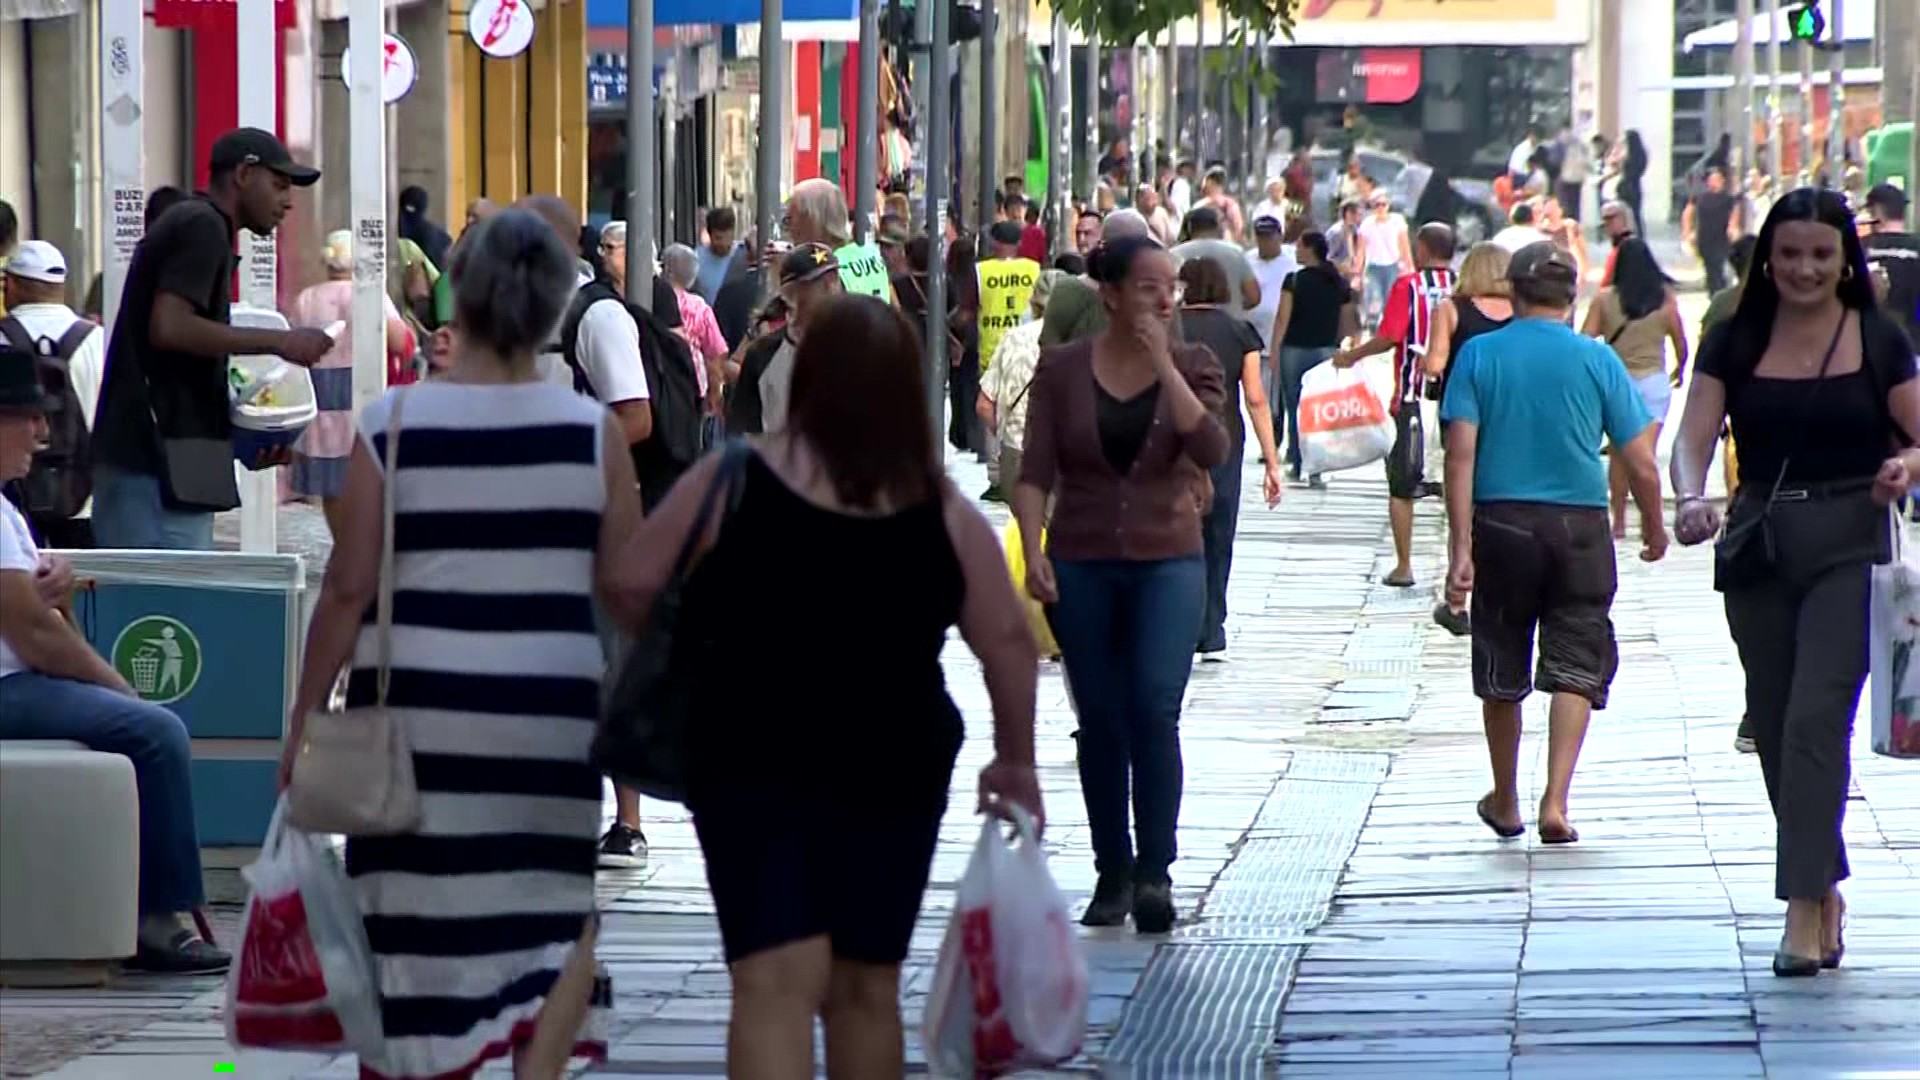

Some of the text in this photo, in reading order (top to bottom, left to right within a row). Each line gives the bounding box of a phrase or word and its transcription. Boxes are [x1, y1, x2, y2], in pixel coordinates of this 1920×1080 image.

[986, 274, 1032, 289] OURO
[1005, 295, 1016, 310] E
[982, 314, 1019, 329] PRAT
